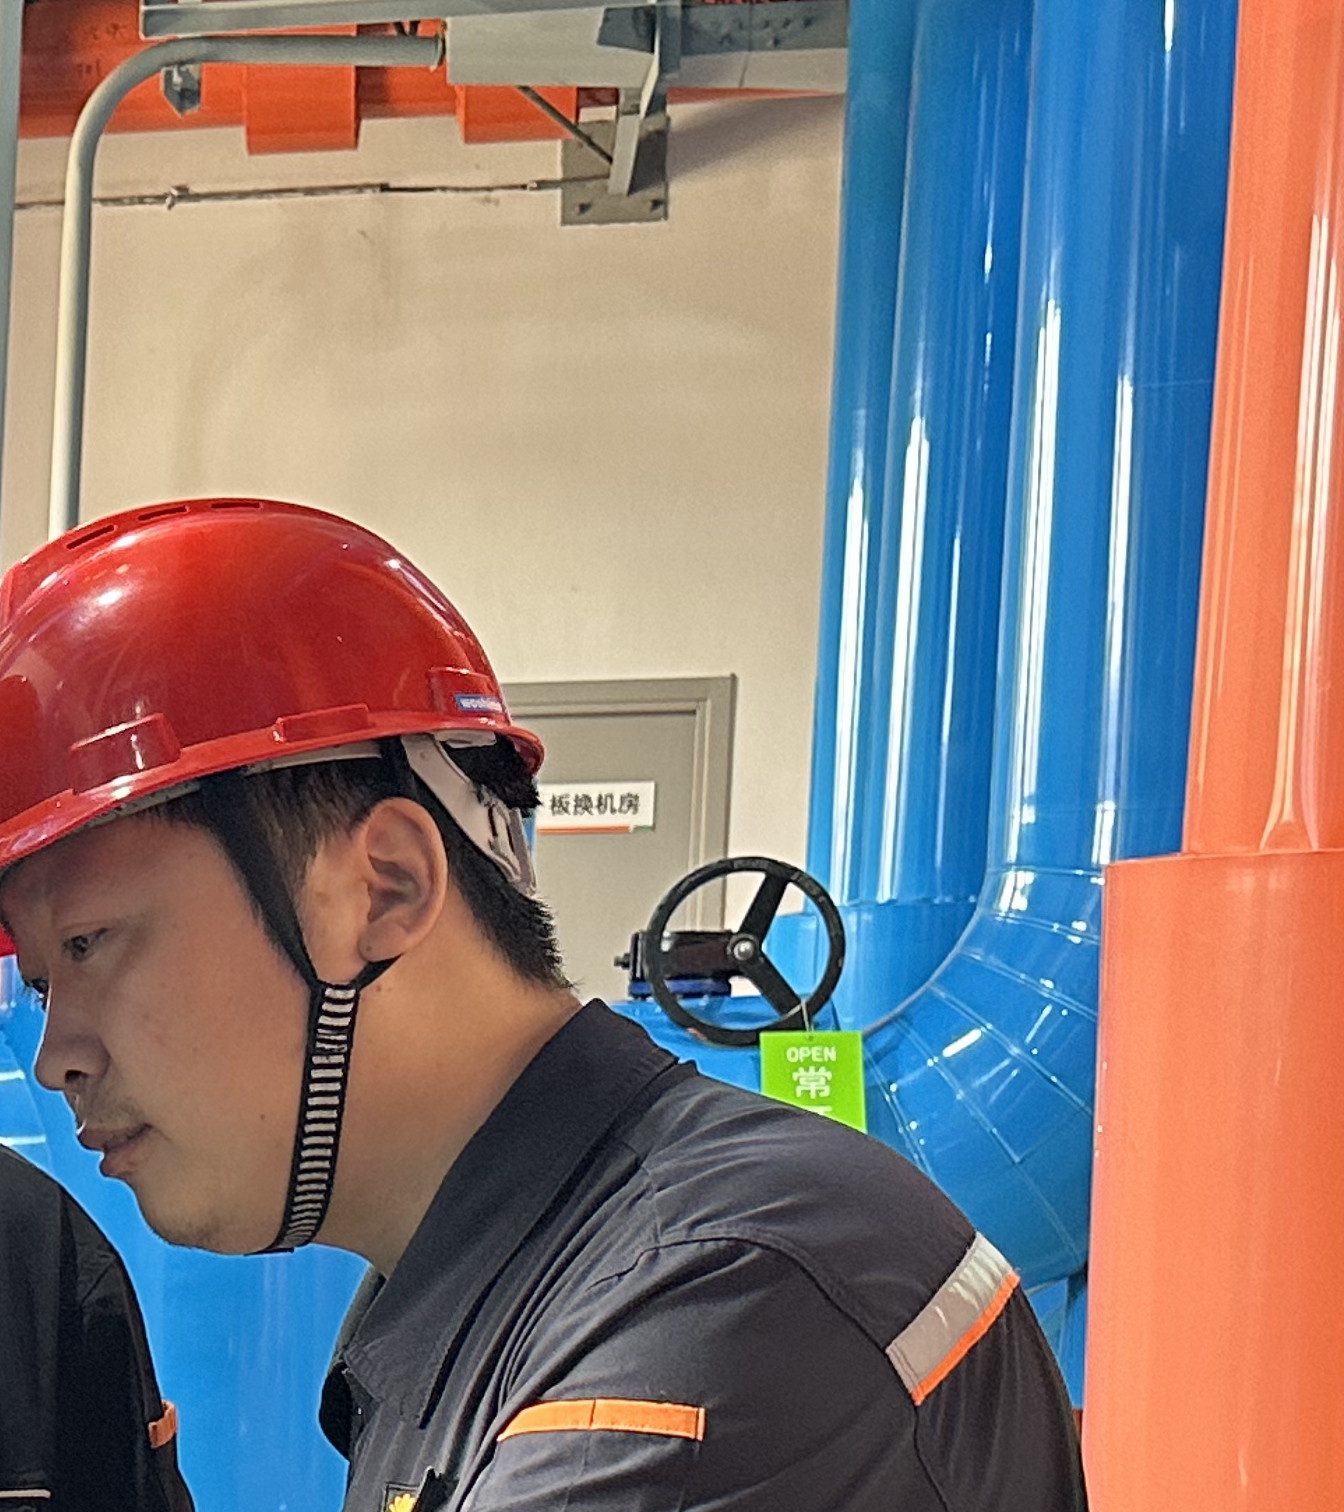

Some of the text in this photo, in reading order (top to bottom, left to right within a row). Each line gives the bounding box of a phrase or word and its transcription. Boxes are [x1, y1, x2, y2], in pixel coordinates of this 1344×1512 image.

[550, 792, 641, 816] 板换机房
[786, 1046, 836, 1062] OPEN
[792, 1066, 832, 1115] 常
